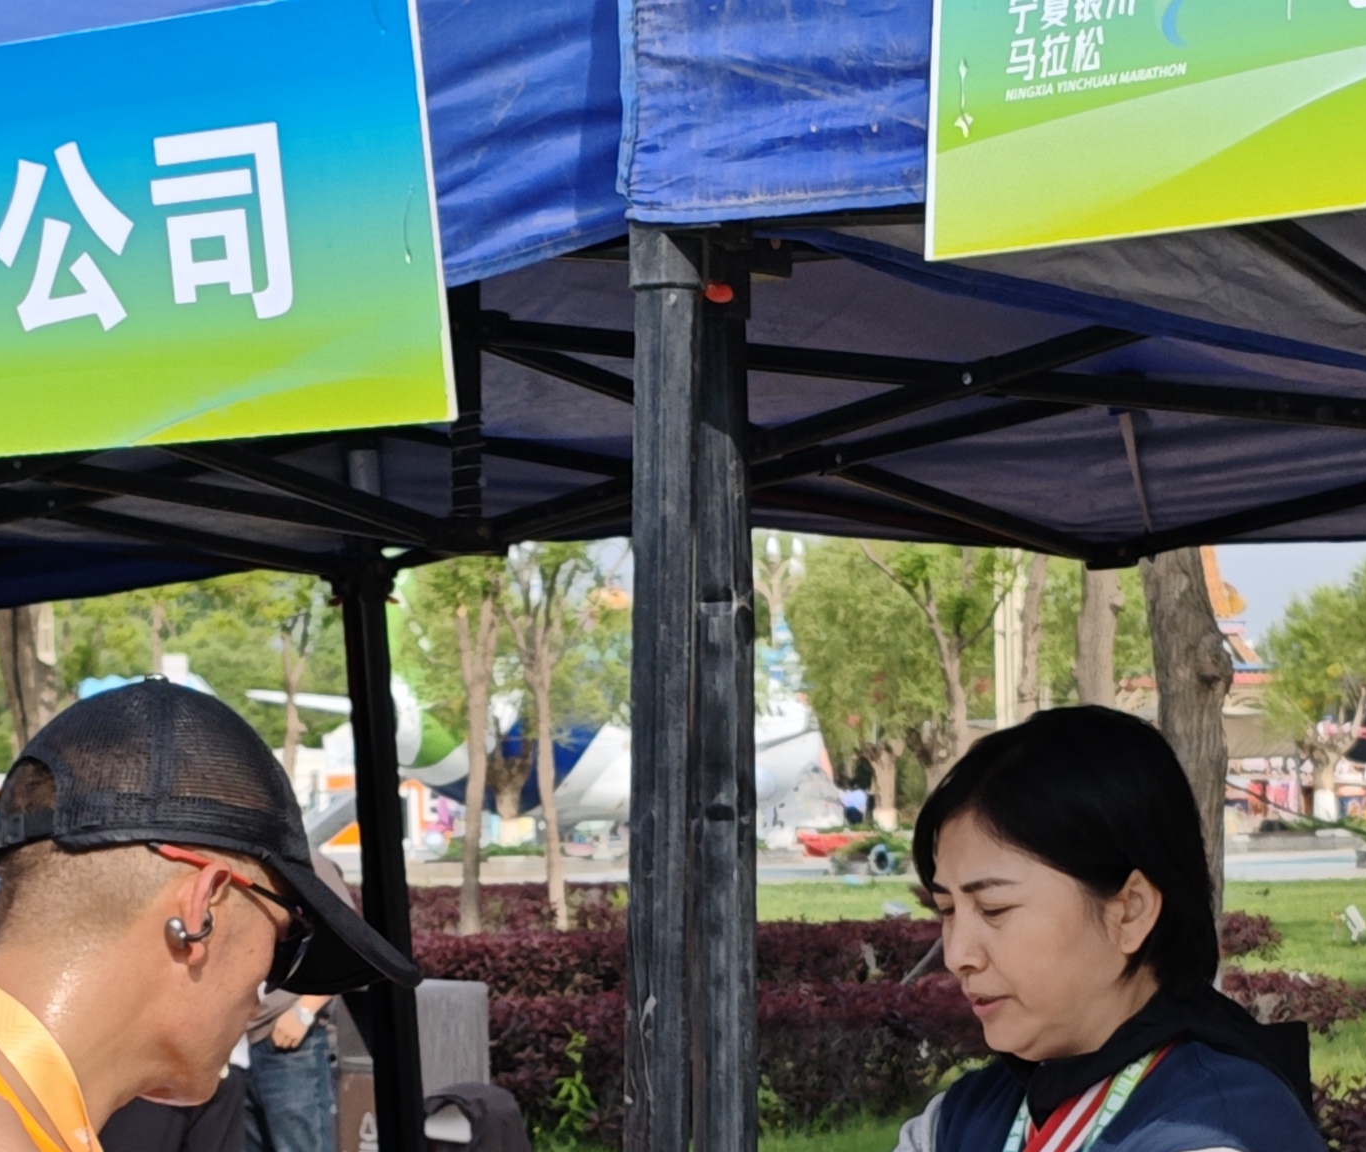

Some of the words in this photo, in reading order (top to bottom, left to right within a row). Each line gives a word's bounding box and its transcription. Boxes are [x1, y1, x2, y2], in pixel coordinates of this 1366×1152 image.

[1006, 26, 1104, 82] 马拉松
[1005, 83, 1054, 101] NINGXIA
[1056, 72, 1118, 95] YINCHUAN
[1119, 62, 1187, 86] MARATHON
